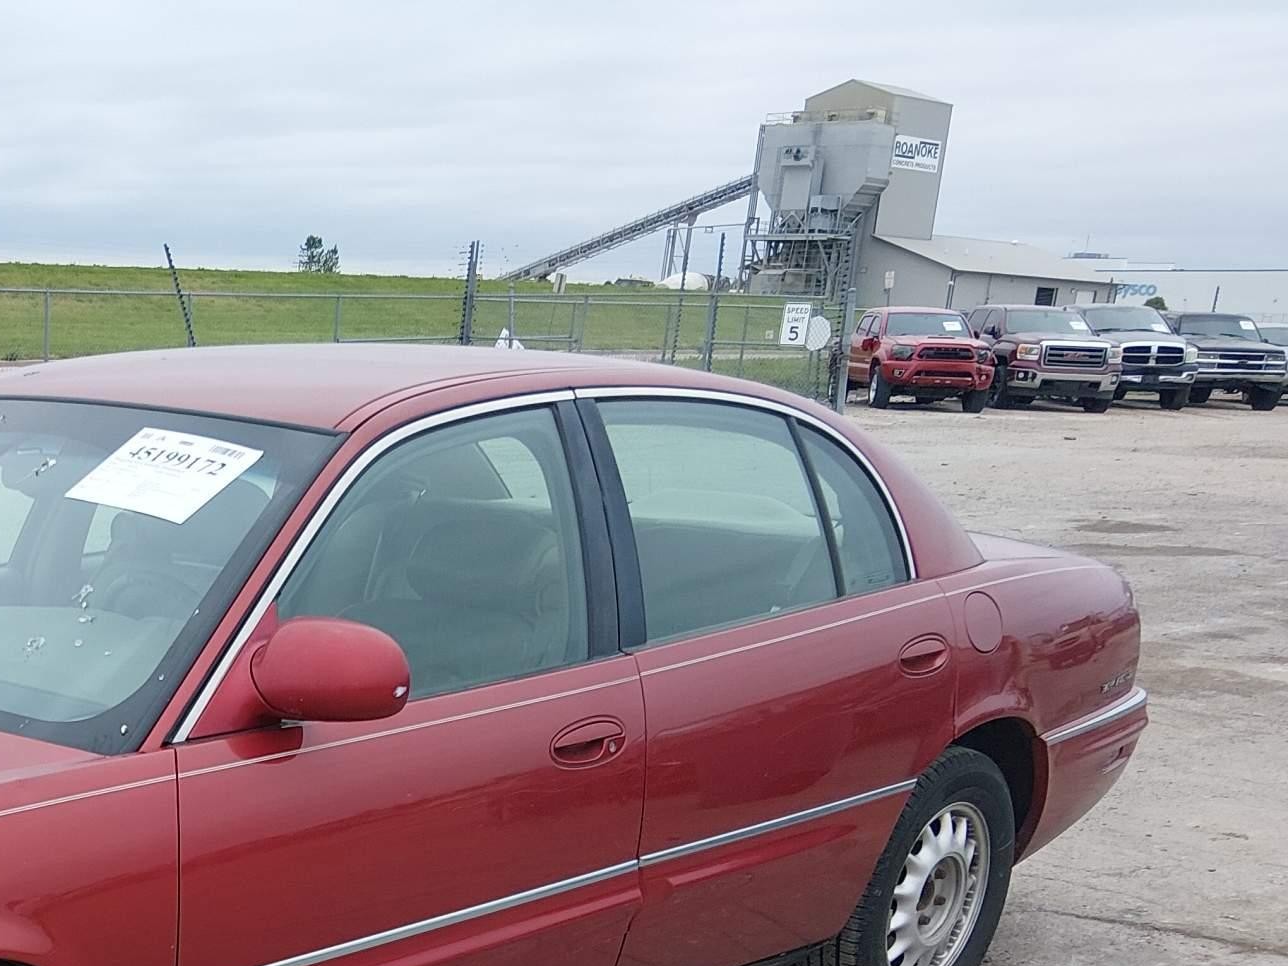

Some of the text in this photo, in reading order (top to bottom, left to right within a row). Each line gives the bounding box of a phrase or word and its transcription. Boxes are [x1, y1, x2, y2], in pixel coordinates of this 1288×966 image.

[895, 141, 939, 159] ROANOKE
[788, 326, 799, 341] 5
[129, 446, 226, 475] 45199172
